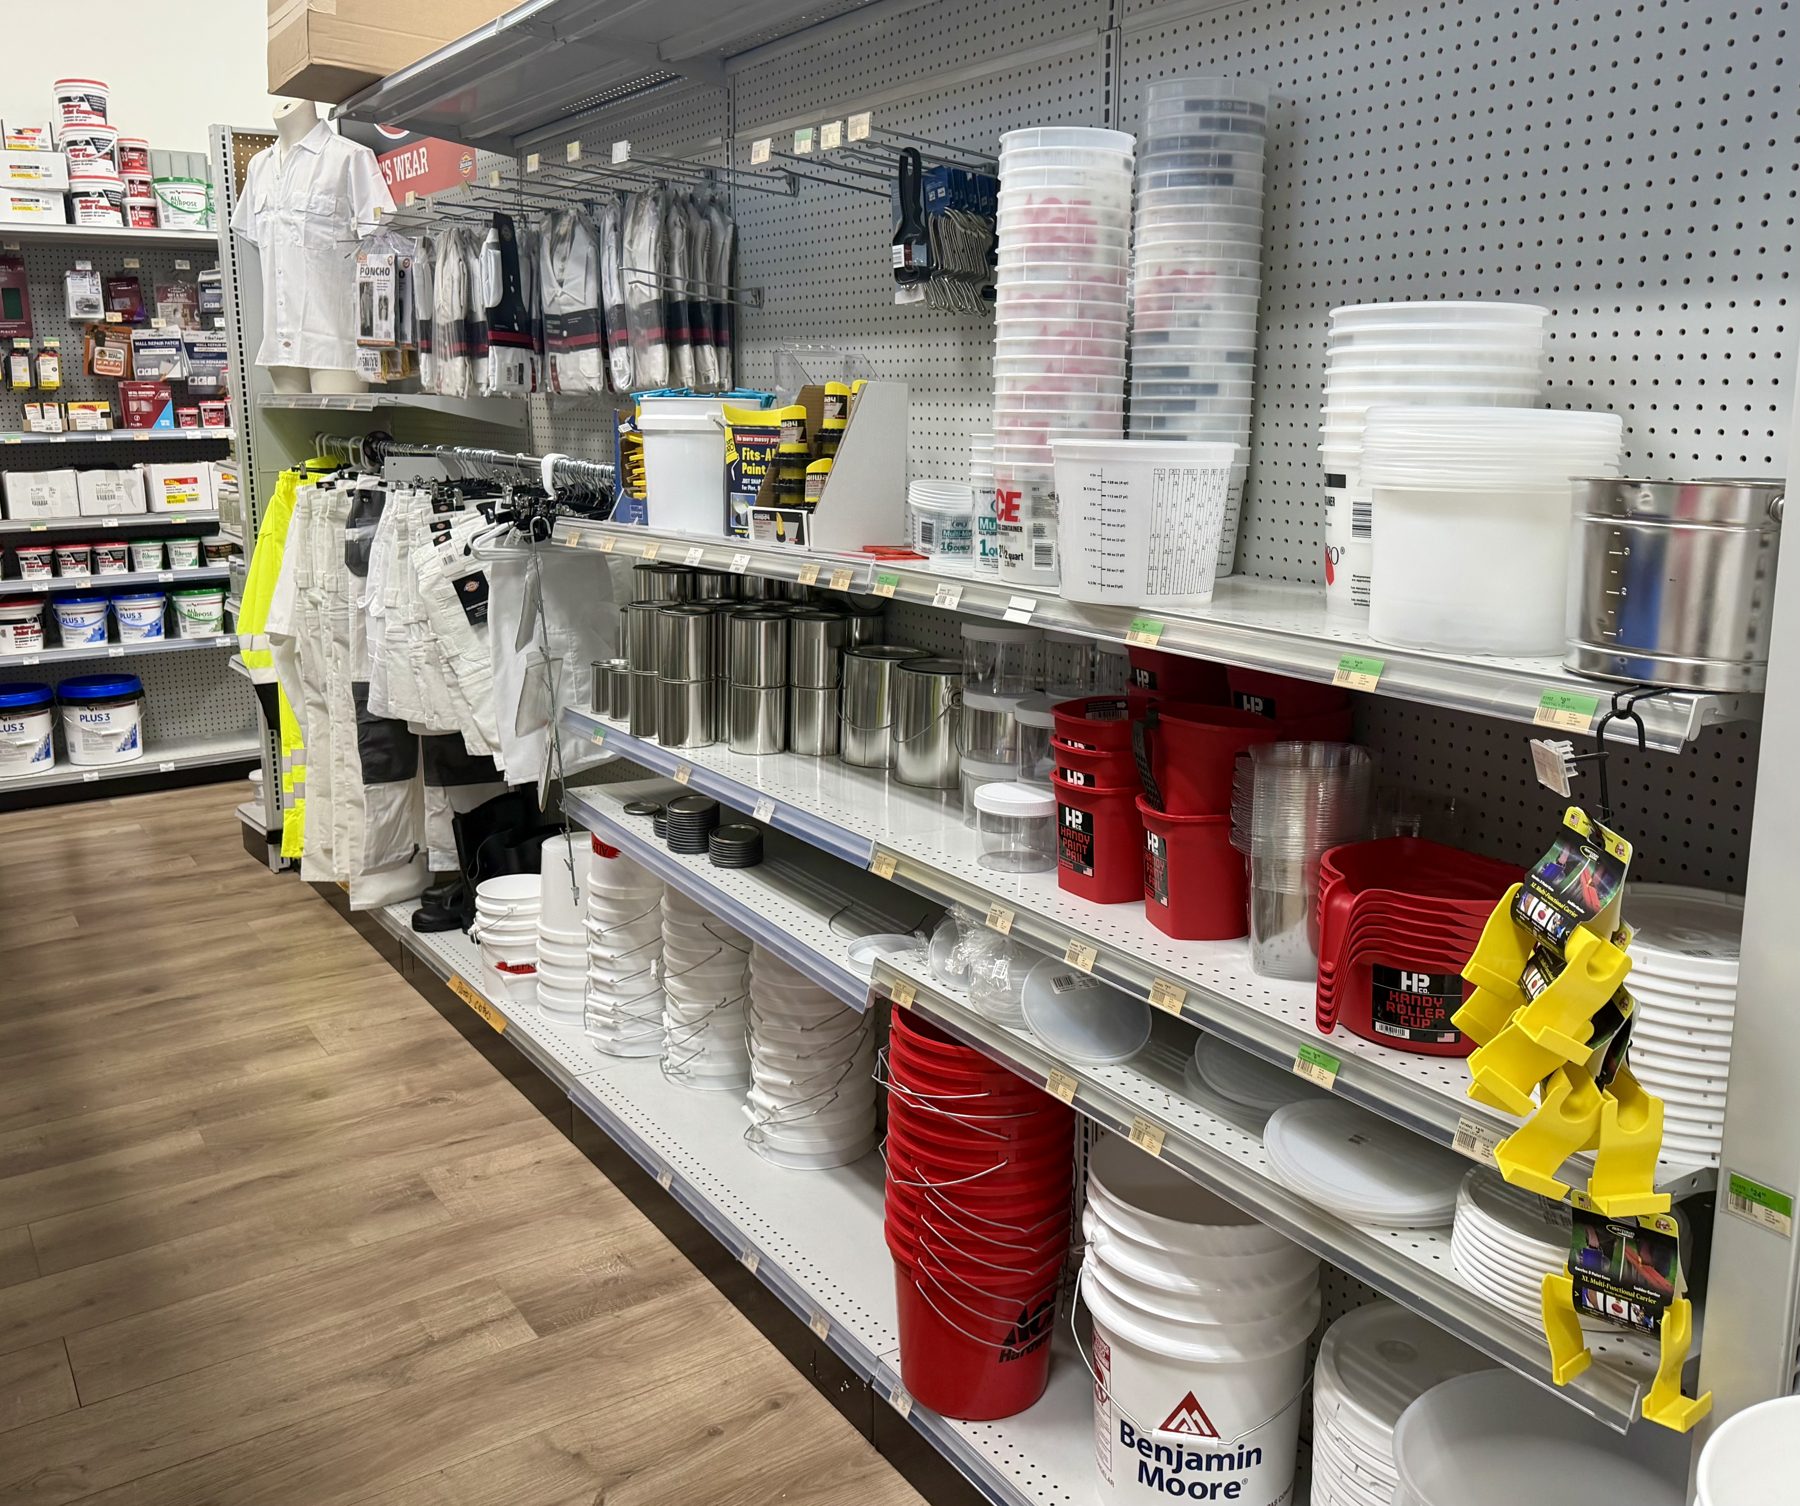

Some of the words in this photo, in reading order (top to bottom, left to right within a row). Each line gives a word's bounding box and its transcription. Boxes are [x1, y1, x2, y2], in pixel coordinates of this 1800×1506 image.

[393, 146, 428, 182] WEAR
[360, 266, 390, 276] PONCHO
[742, 462, 766, 475] Paint
[940, 542, 953, 552] 16
[980, 539, 988, 557] 1
[1624, 547, 1631, 556] 3
[1008, 553, 1024, 561] quart
[1621, 587, 1628, 596] 2
[80, 713, 102, 723] PLUS
[104, 713, 110, 721] 3
[19, 722, 24, 731] 3
[1065, 807, 1082, 829] HP
[1060, 826, 1090, 845] HANDY
[1147, 830, 1158, 852] HP
[1062, 838, 1088, 854] PAINT
[1066, 848, 1086, 864] PAIL
[1401, 971, 1430, 992] HP
[1390, 990, 1443, 1007] HANDY
[1386, 1002, 1446, 1019] ROLLER
[1400, 1016, 1431, 1028] CUP
[1591, 1278, 1635, 1298] Multi-Functional
[1636, 1292, 1656, 1304] Carrier
[1120, 1418, 1262, 1474] Benjamin
